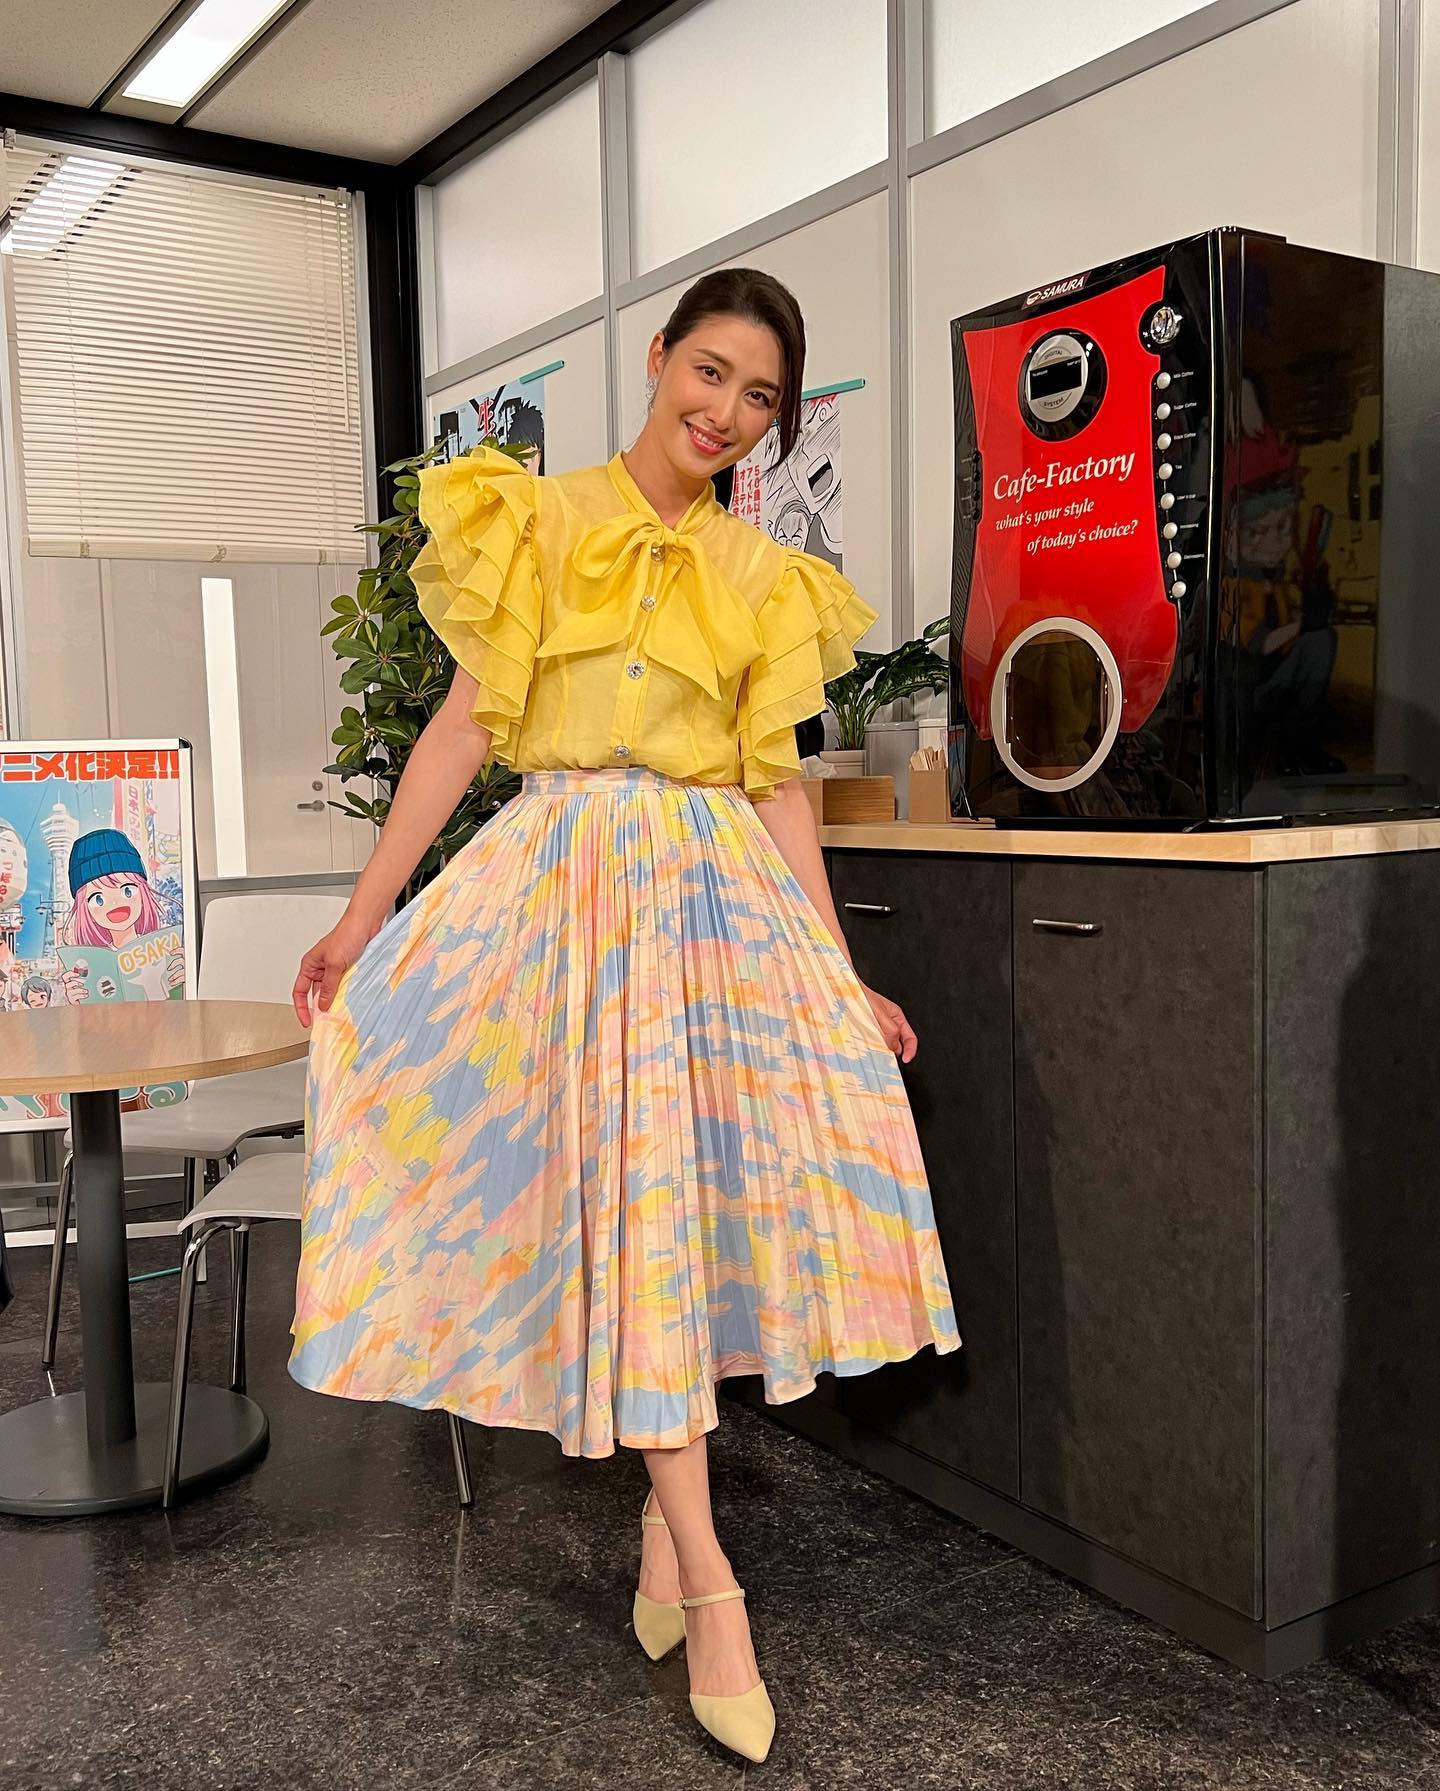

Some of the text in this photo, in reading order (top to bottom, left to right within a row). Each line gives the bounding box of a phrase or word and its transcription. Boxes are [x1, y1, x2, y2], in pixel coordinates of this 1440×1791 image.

[1041, 276, 1085, 300] SAMURA
[1043, 397, 1064, 407] SYSTEM
[993, 452, 1136, 503] Cafe-Factory
[995, 497, 1095, 531] what's your style
[1027, 519, 1138, 556] of today's choice?
[117, 932, 182, 974] OSAKA
